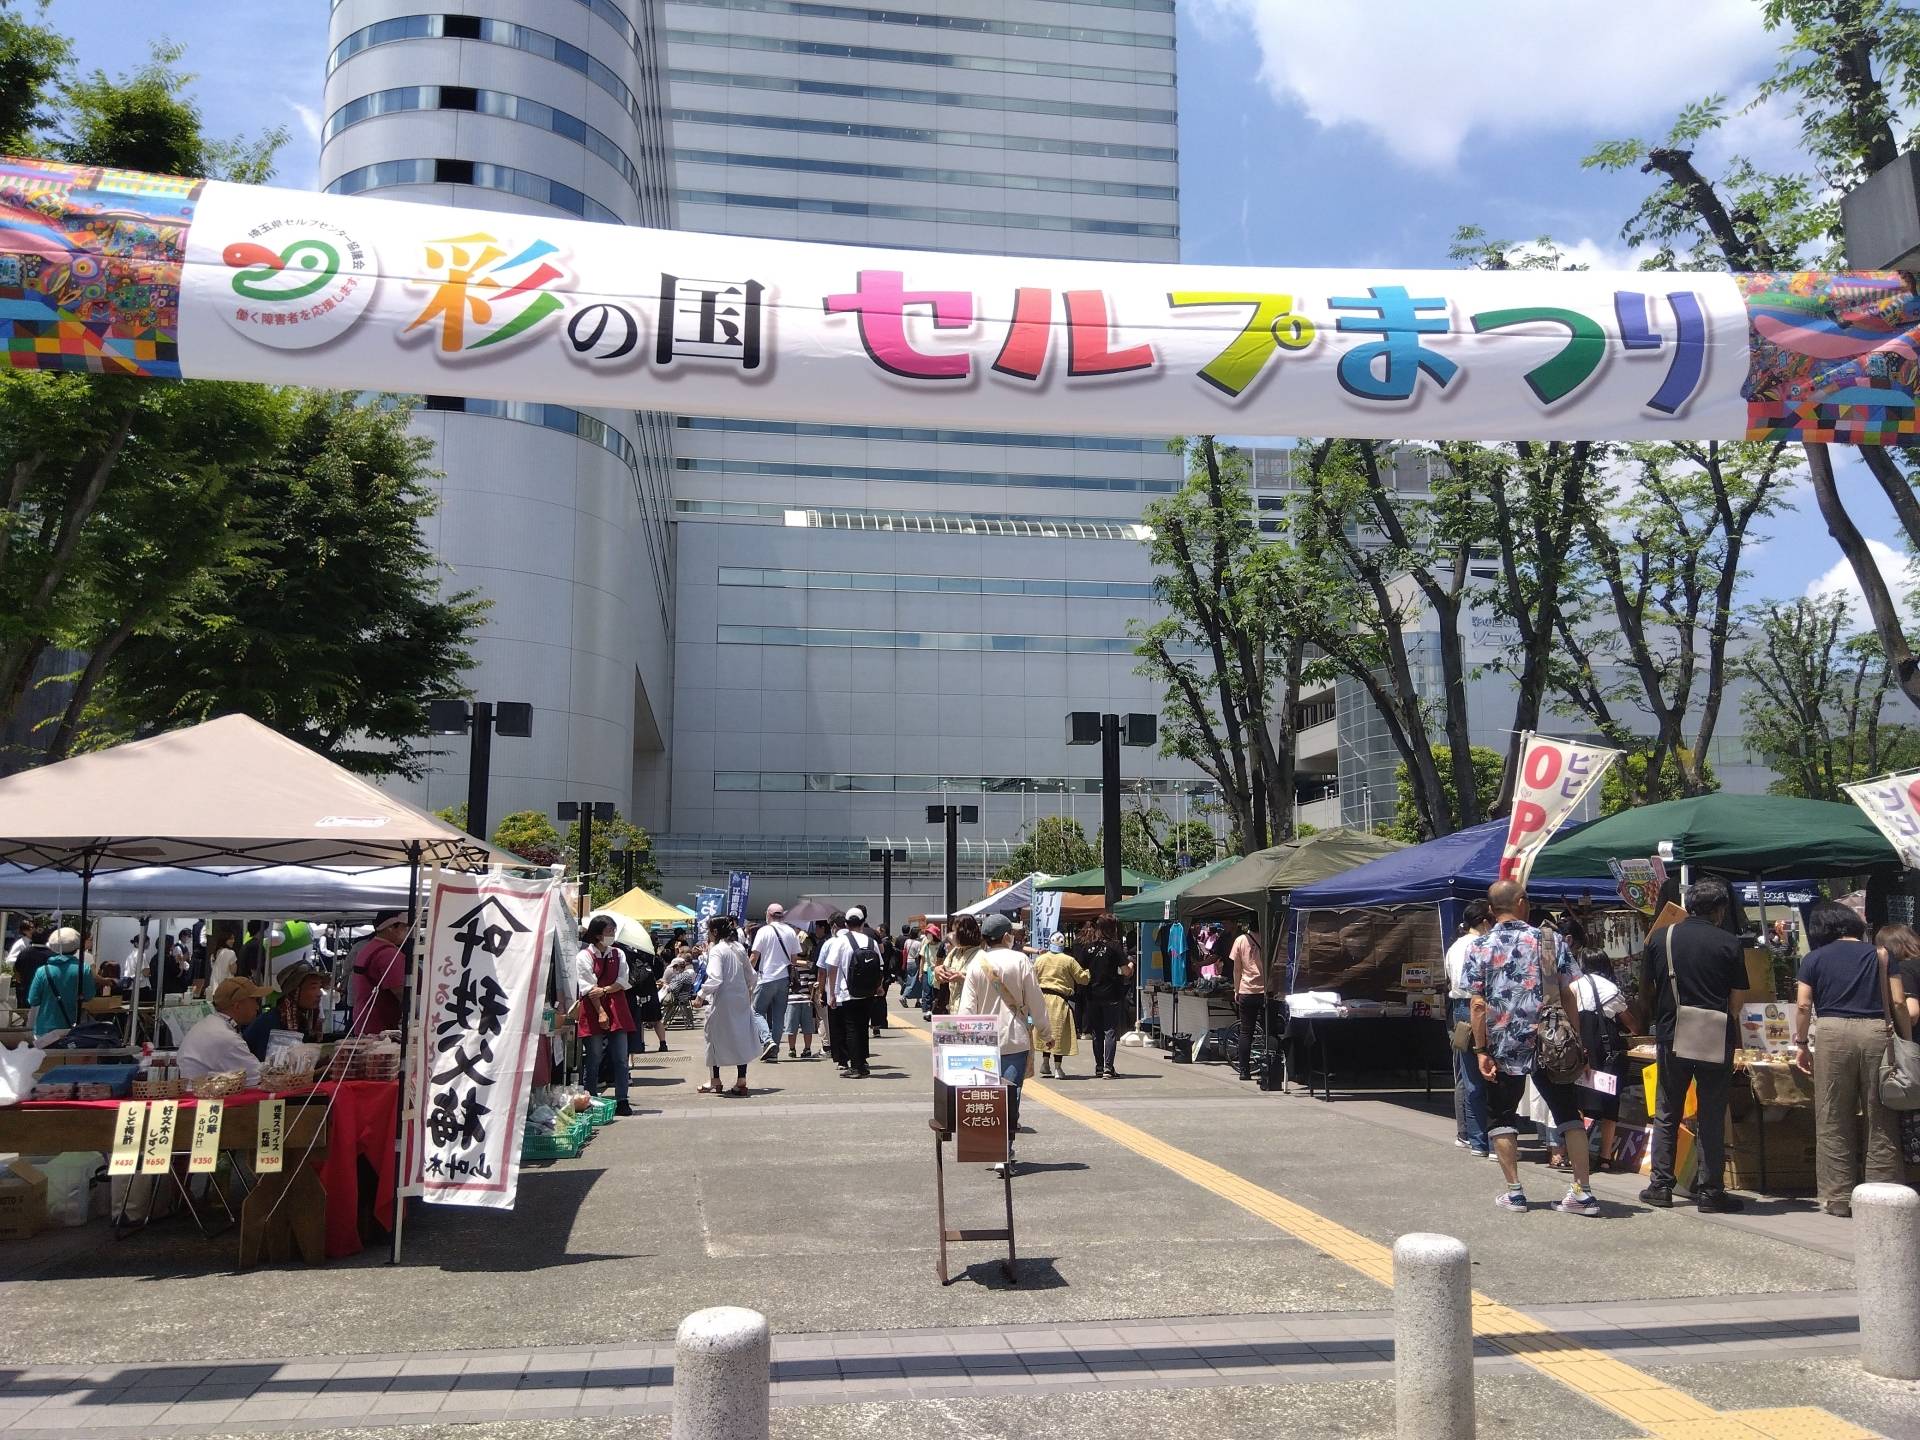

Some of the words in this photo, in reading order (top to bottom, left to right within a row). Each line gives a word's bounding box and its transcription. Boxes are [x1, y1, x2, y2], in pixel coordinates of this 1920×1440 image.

[823, 269, 1708, 415] セルプまつり
[961, 1089, 1000, 1101] ご自由に
[965, 1102, 994, 1114] お持ち
[962, 1116, 1001, 1127] ください
